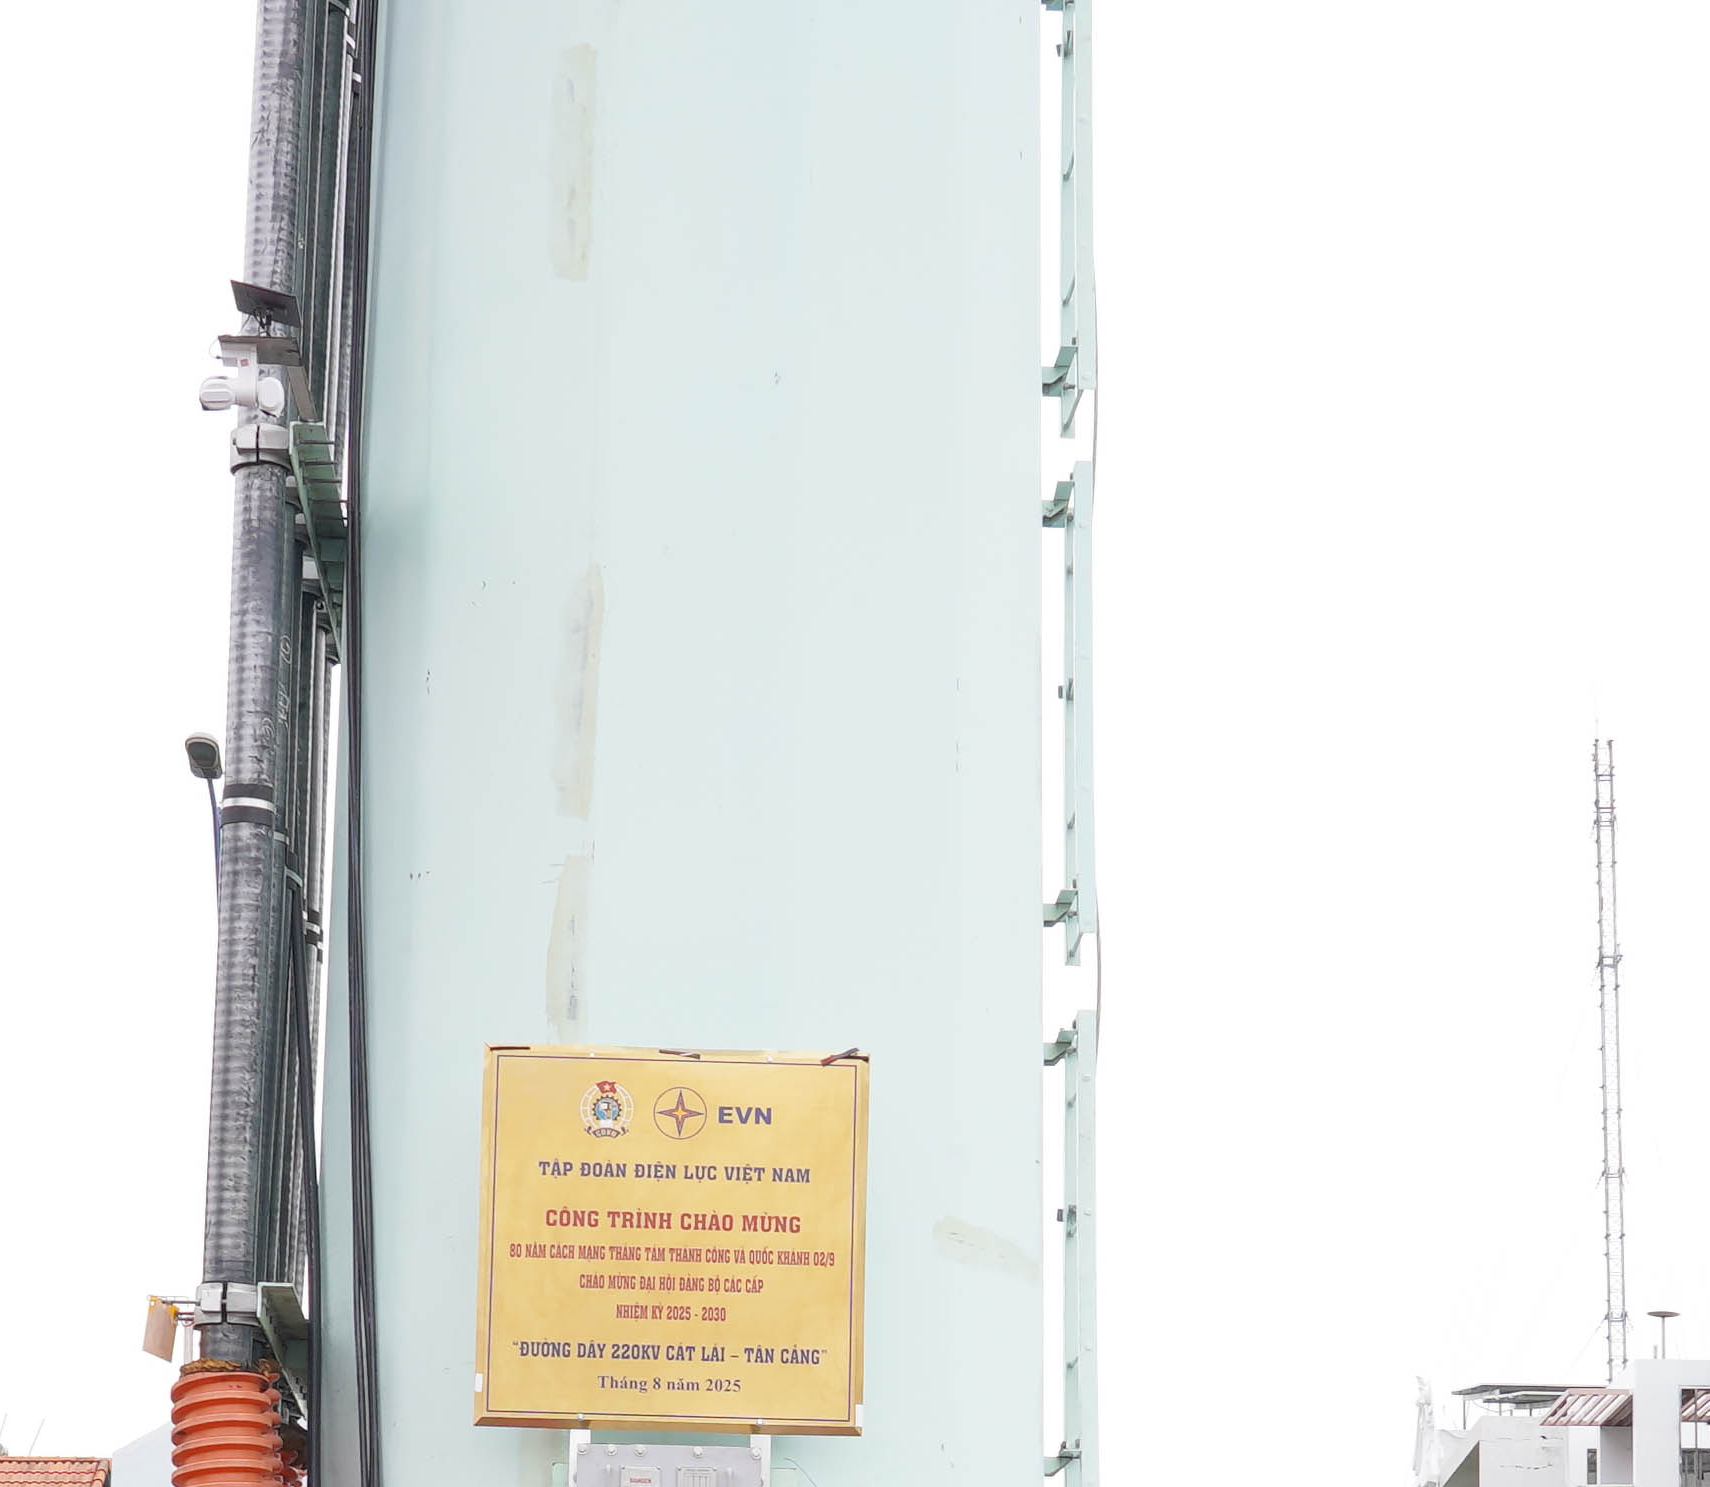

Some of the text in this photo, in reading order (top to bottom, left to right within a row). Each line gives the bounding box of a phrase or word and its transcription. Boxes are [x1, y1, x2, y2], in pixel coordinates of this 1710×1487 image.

[718, 1106, 772, 1125] EVN
[539, 1159, 811, 1184] TẬP ĐOÀN ĐIỆN LỰC VIỆT NAM
[545, 1206, 801, 1233] CÔNG TRÌNH CHÀO MỪNG
[509, 1243, 522, 1258] 80
[525, 1241, 546, 1259] NĂM
[550, 1242, 574, 1259] CÁCH
[578, 1245, 605, 1262] MẠNG
[609, 1243, 641, 1261] THÁNG
[645, 1245, 665, 1262] TÁM
[705, 1246, 730, 1264] CÔNG
[734, 1246, 746, 1264] VÀ
[749, 1247, 774, 1265] QUỐC
[777, 1247, 810, 1266] KHÁNH
[813, 1251, 835, 1267] 02/9
[579, 1272, 764, 1295] CHÀO MỪNG ĐẠI HỘI ĐẢNG BỘ CÁC CẤP
[616, 1303, 648, 1321] NHIỆM
[651, 1302, 664, 1320] KỲ
[666, 1305, 691, 1321] 2025
[701, 1306, 726, 1322] 2030
[577, 1340, 606, 1359] DÂY
[611, 1343, 661, 1360] 220KV
[666, 1342, 696, 1361] CÁT
[701, 1343, 725, 1362] LÁI
[744, 1344, 774, 1364] TÂN
[598, 1375, 741, 1393] Tháng 8 năm 2025
